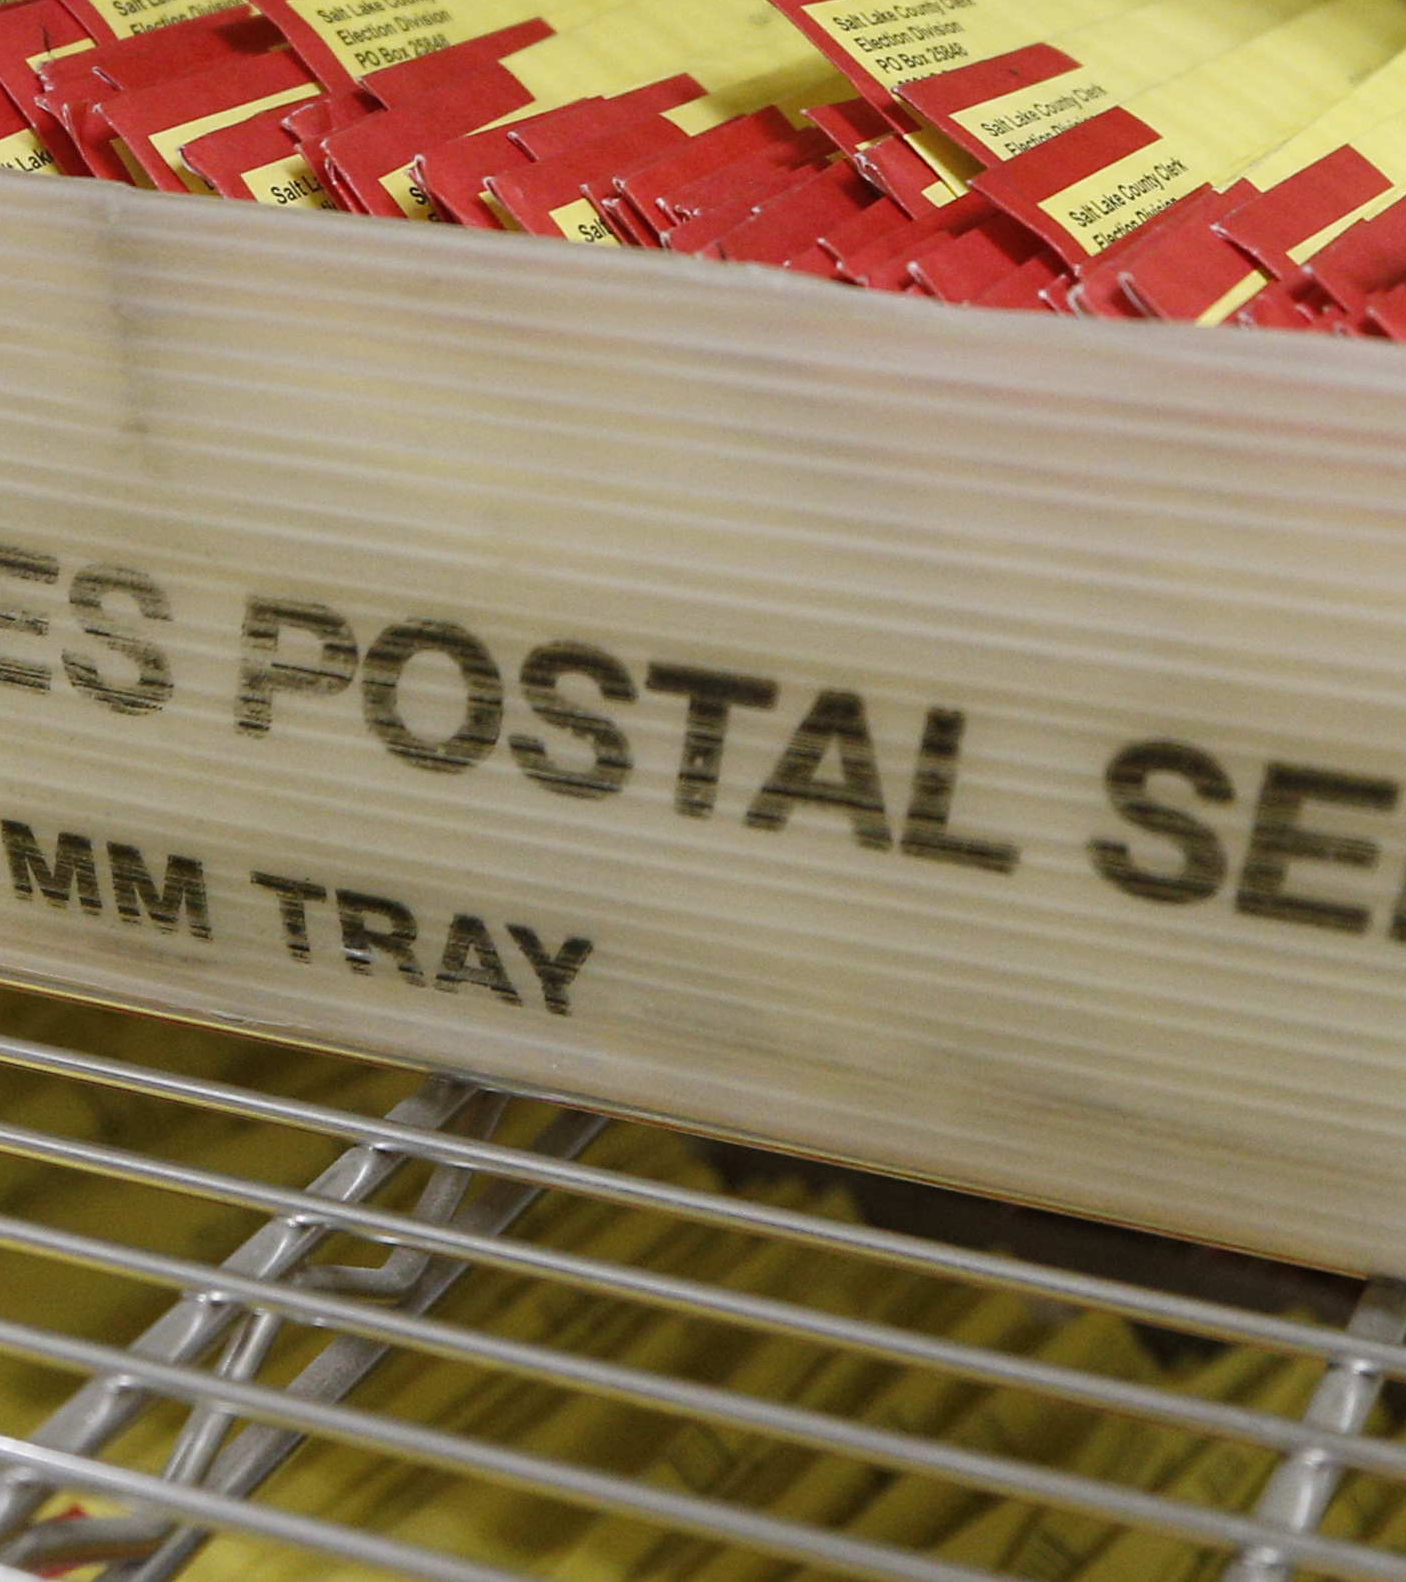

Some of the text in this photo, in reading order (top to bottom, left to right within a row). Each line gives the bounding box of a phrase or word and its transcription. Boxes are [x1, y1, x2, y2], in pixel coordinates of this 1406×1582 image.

[315, 6, 353, 25] Salt
[345, 1, 387, 18] Lake
[336, 8, 453, 47] Election Division
[832, 12, 863, 32] Salt
[859, 8, 898, 27] Lake
[892, 0, 946, 19] County
[853, 21, 967, 53] Election Division
[353, 50, 382, 70] PO
[378, 43, 410, 65] Box
[875, 58, 904, 74] PO
[897, 52, 929, 70] Box
[980, 117, 1013, 138] Salt
[1005, 110, 1042, 128] Lake
[1033, 95, 1084, 121] County
[1072, 83, 1110, 103] Clerk
[270, 178, 309, 206] Salt
[1068, 156, 1190, 228] Salt Lake County Clerk
[232, 592, 1021, 876] POSTAL
[0, 818, 594, 1018] MM TRAY
